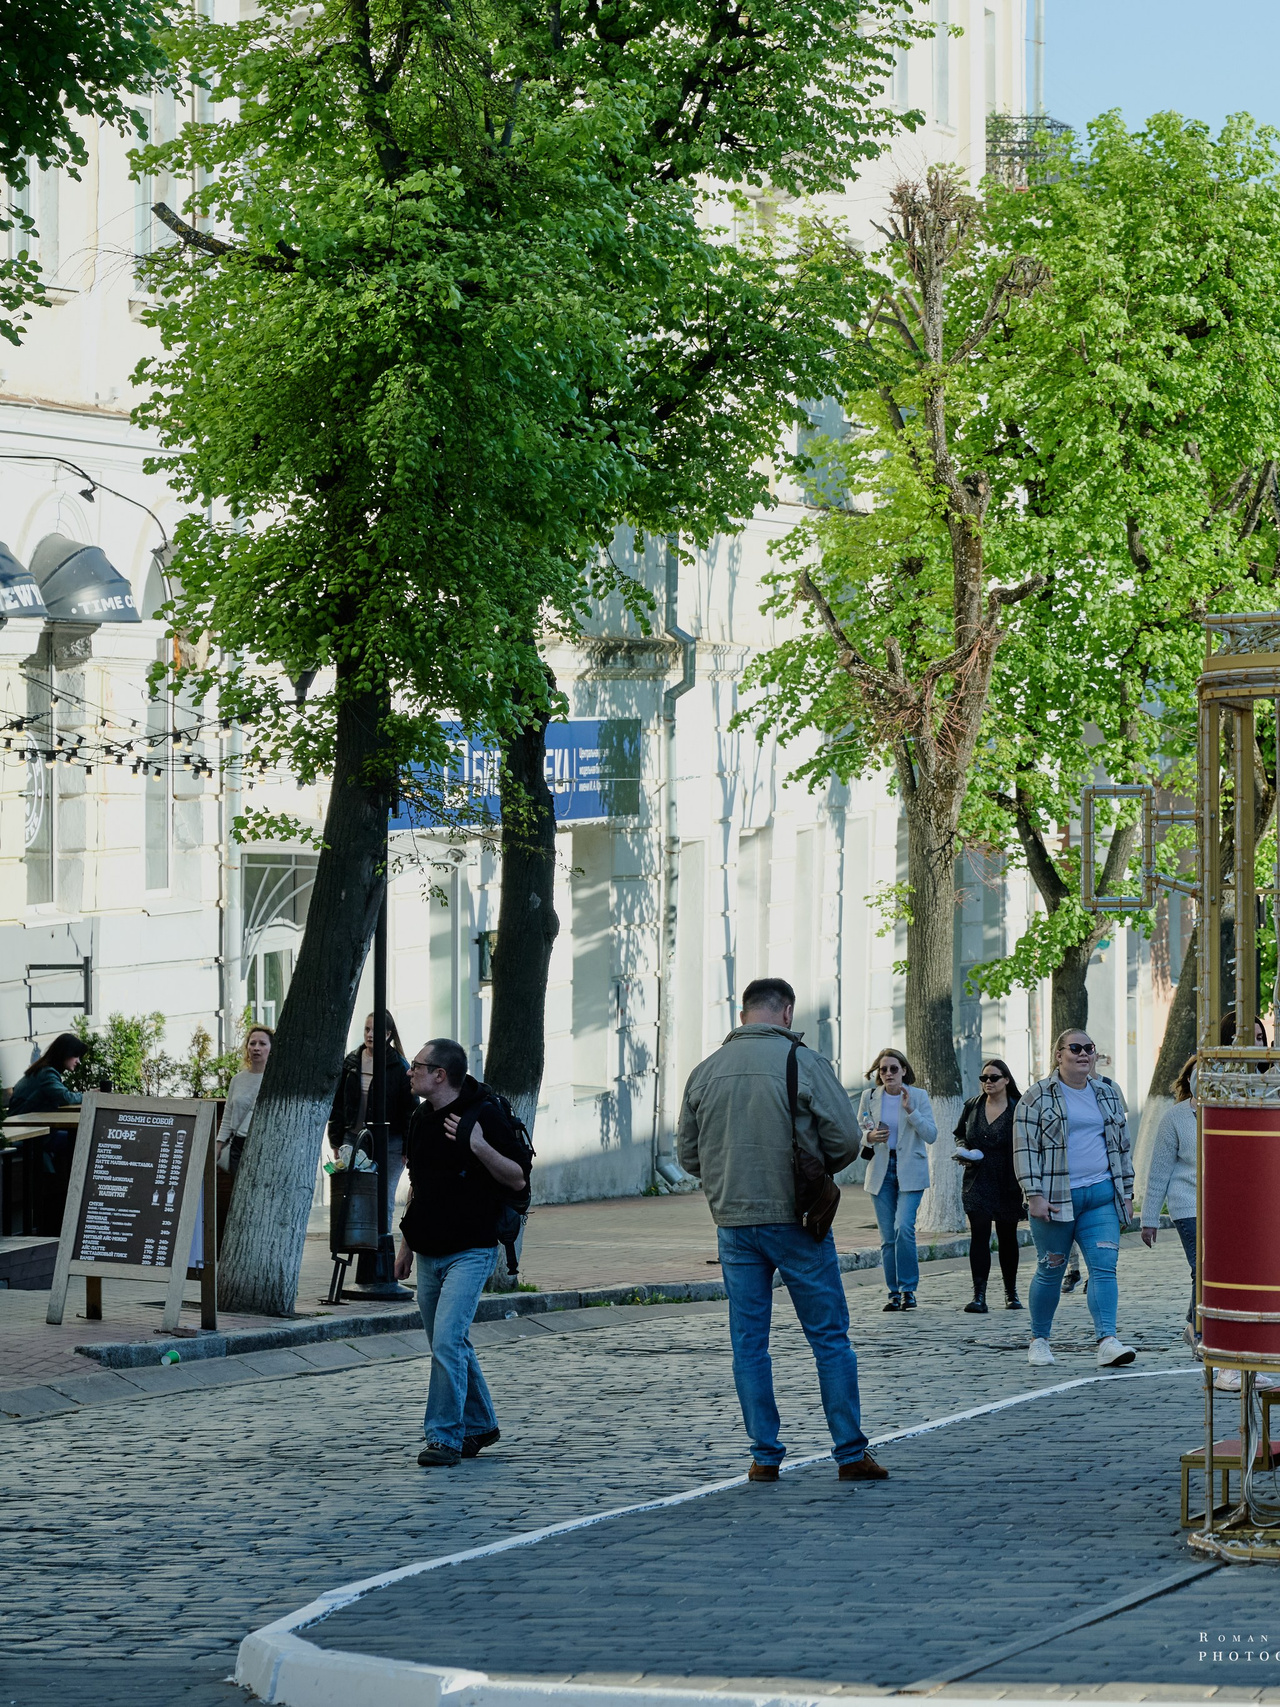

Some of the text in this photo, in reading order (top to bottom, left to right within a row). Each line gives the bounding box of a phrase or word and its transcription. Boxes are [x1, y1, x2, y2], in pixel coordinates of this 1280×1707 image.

[77, 595, 124, 615] TIME
[118, 1115, 146, 1123] ВОЗЬМИ
[152, 1117, 174, 1125] СОБОЙ
[107, 1129, 137, 1140] КОФЕ
